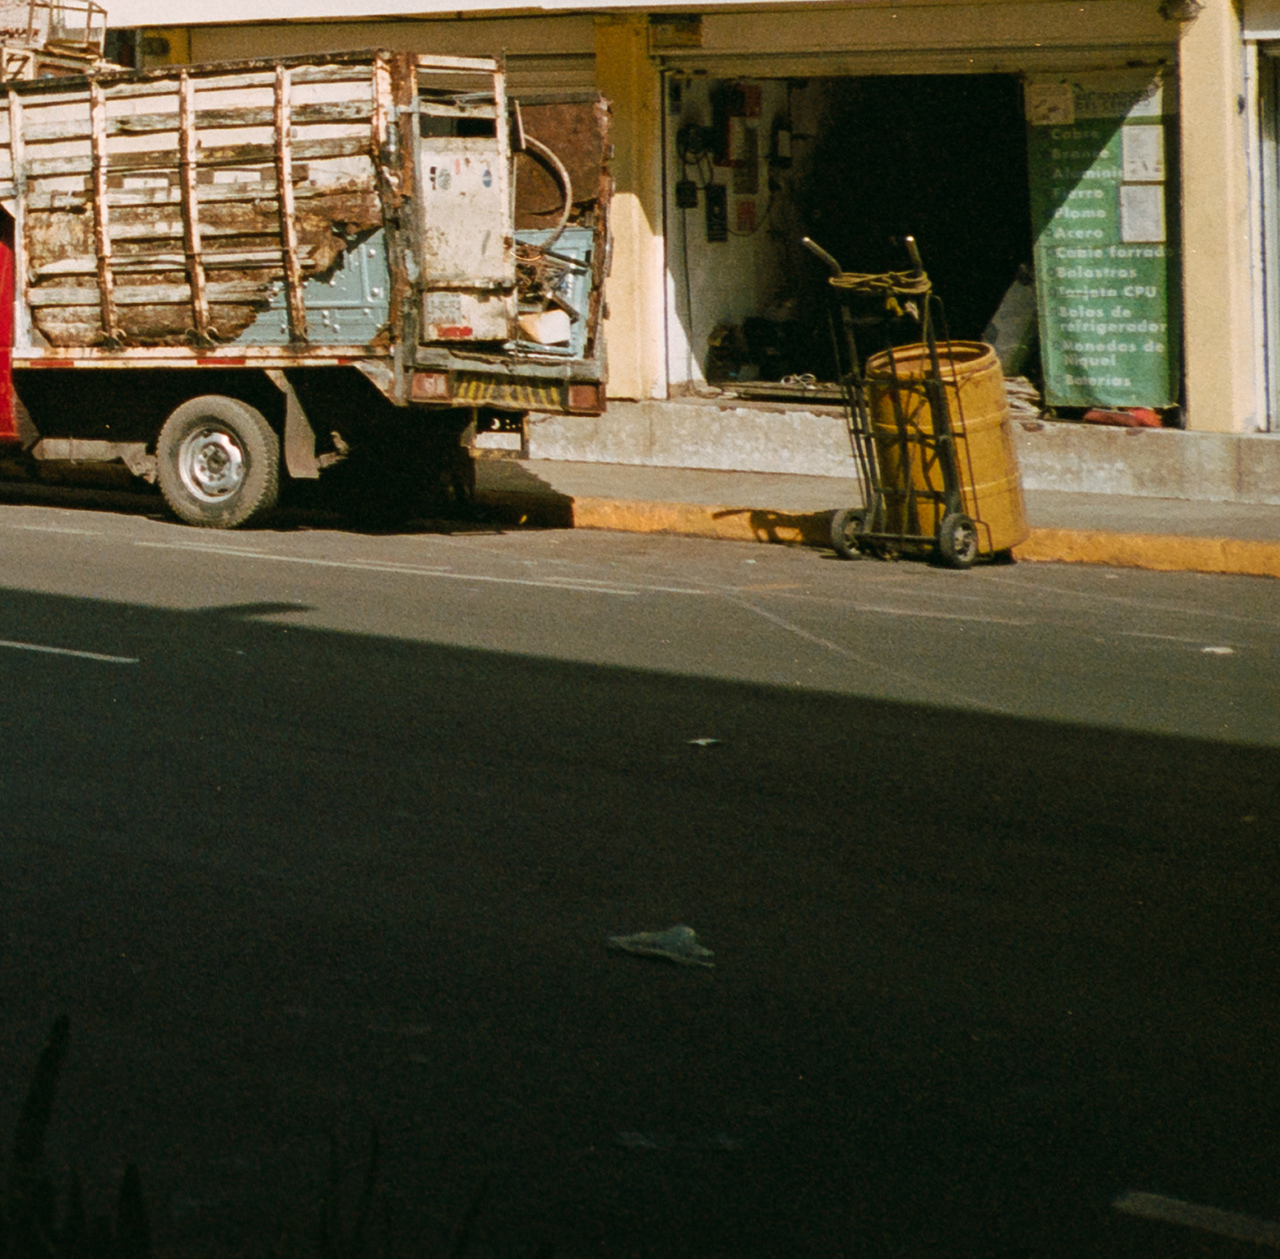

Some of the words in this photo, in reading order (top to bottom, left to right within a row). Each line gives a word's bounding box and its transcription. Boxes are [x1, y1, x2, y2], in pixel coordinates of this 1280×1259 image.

[1053, 227, 1104, 239] Acero
[1124, 285, 1158, 298] CPU
[1110, 305, 1132, 318] de
[1142, 340, 1166, 353] de
